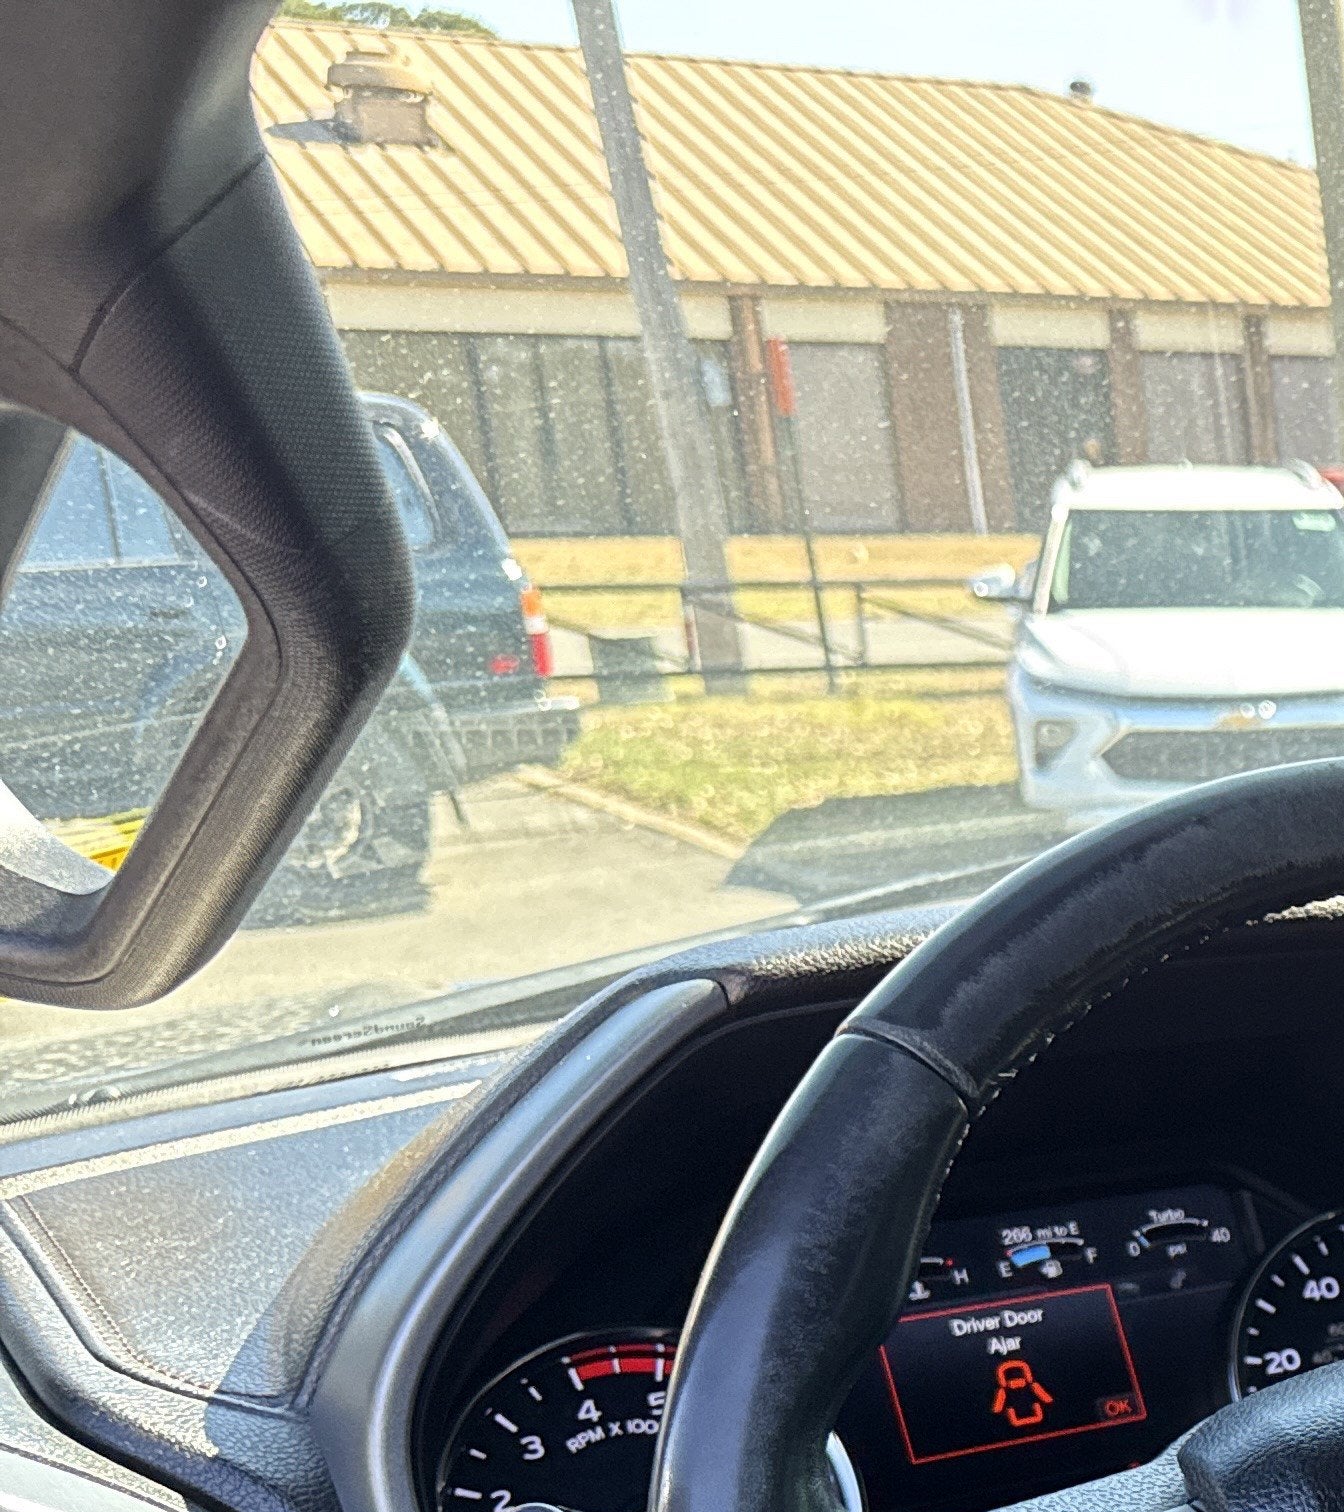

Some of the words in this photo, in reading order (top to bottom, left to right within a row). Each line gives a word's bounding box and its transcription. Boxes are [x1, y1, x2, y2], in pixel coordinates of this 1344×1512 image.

[1054, 1225, 1068, 1237] to
[1069, 1220, 1080, 1236] E
[1211, 1226, 1231, 1243] 40
[1085, 1246, 1098, 1264] F
[1128, 1241, 1141, 1257] 0
[952, 1267, 970, 1286] H
[998, 1260, 1013, 1279] E
[1302, 1275, 1340, 1302] 40
[950, 1314, 1001, 1337] Driver
[1002, 1308, 1044, 1328] Door
[987, 1335, 1023, 1356] Ajar
[1263, 1347, 1301, 1375] 20
[577, 1399, 603, 1422] 4
[1104, 1400, 1134, 1418] OK
[519, 1435, 546, 1461] 3
[565, 1425, 606, 1454] RPM
